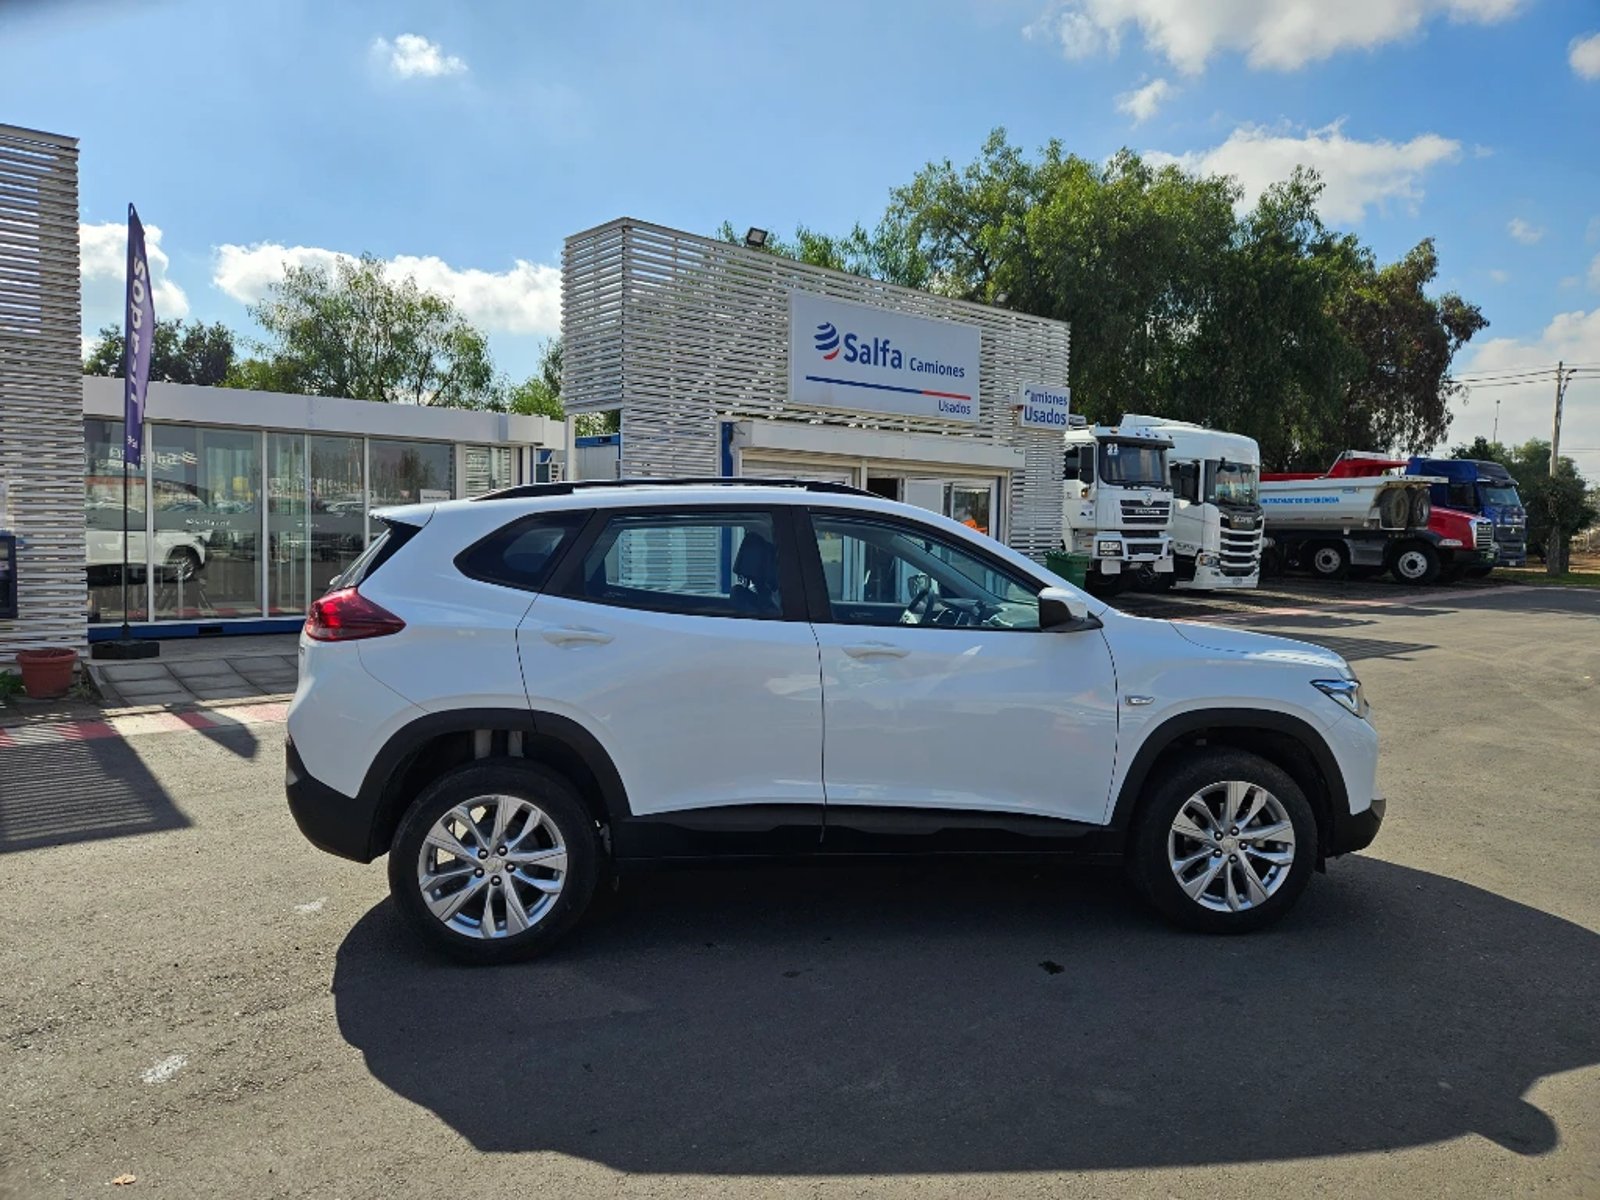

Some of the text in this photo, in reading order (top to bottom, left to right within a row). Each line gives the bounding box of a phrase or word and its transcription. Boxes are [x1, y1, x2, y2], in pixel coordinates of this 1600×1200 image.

[843, 333, 965, 378] Salfa Camiones
[938, 399, 971, 415] Usados
[1024, 405, 1067, 426] Usados
